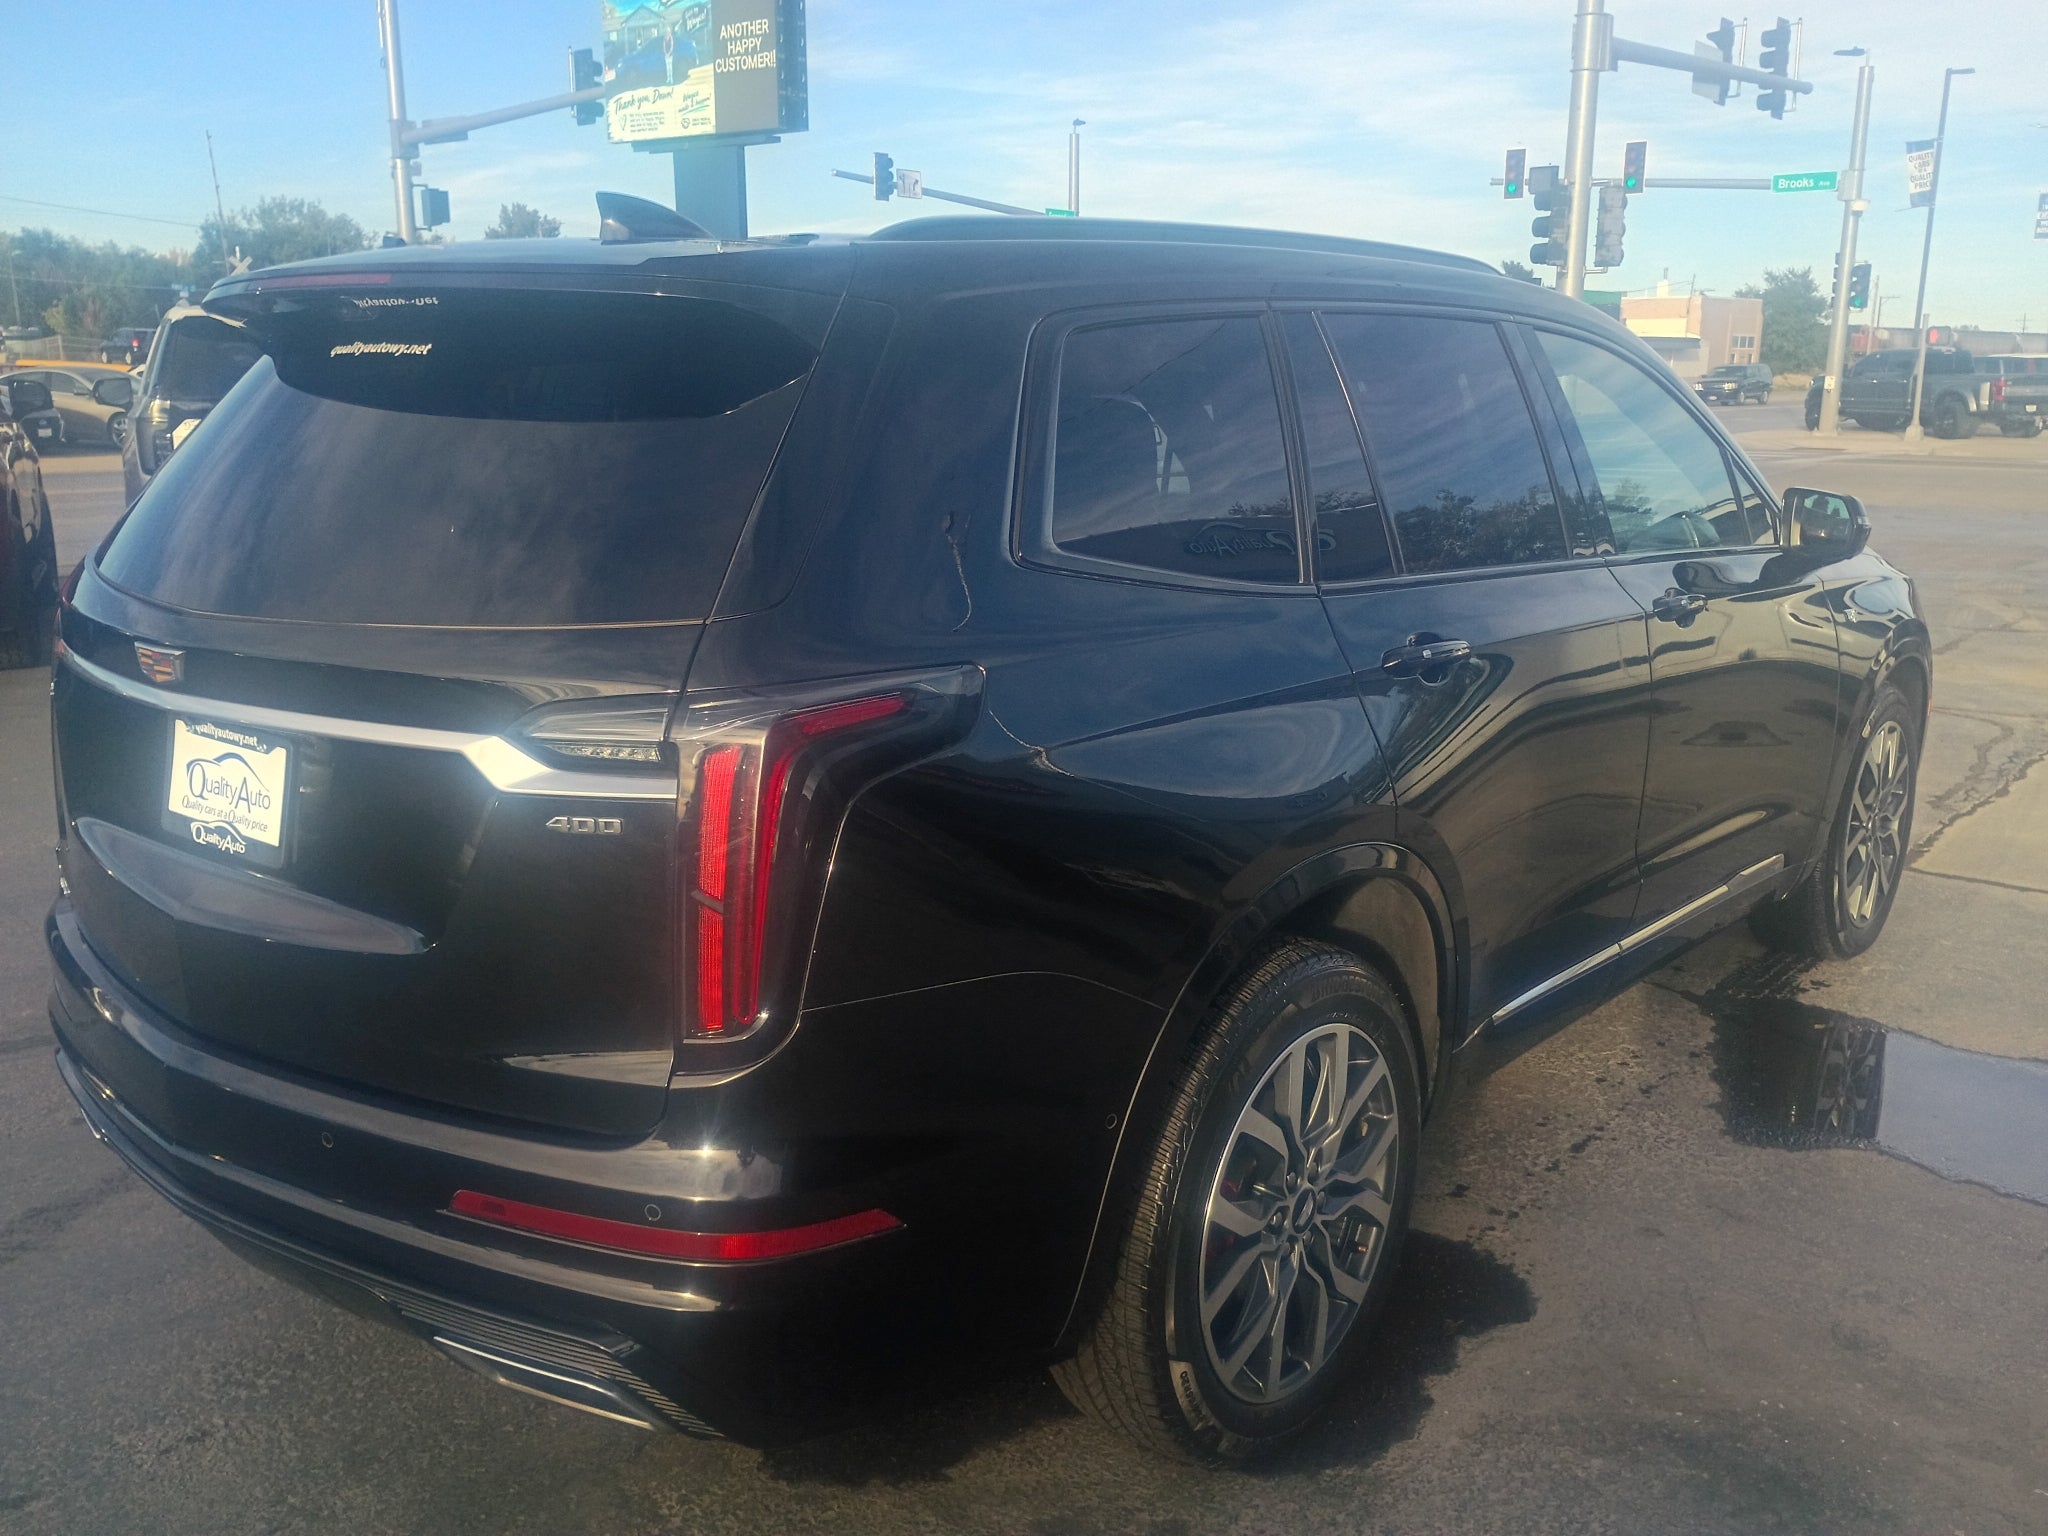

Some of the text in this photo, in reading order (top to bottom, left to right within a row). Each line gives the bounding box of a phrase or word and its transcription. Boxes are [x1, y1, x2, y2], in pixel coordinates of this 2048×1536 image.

[720, 19, 769, 40] ANOTHER
[727, 36, 762, 56] HAPPY
[715, 49, 776, 72] CUSTOMER!!
[613, 94, 635, 115] Thank
[1778, 177, 1814, 189] Brooks
[1910, 171, 1934, 183] QUALIT
[1914, 180, 1930, 190] PRIC
[330, 341, 433, 358] qualityautowy.net
[196, 722, 258, 746] qualityautowy.net
[182, 795, 204, 814] Quality
[204, 806, 217, 816] cars
[217, 809, 224, 819] at
[228, 810, 251, 830] Quality
[251, 818, 268, 832] price
[545, 816, 623, 835] 400
